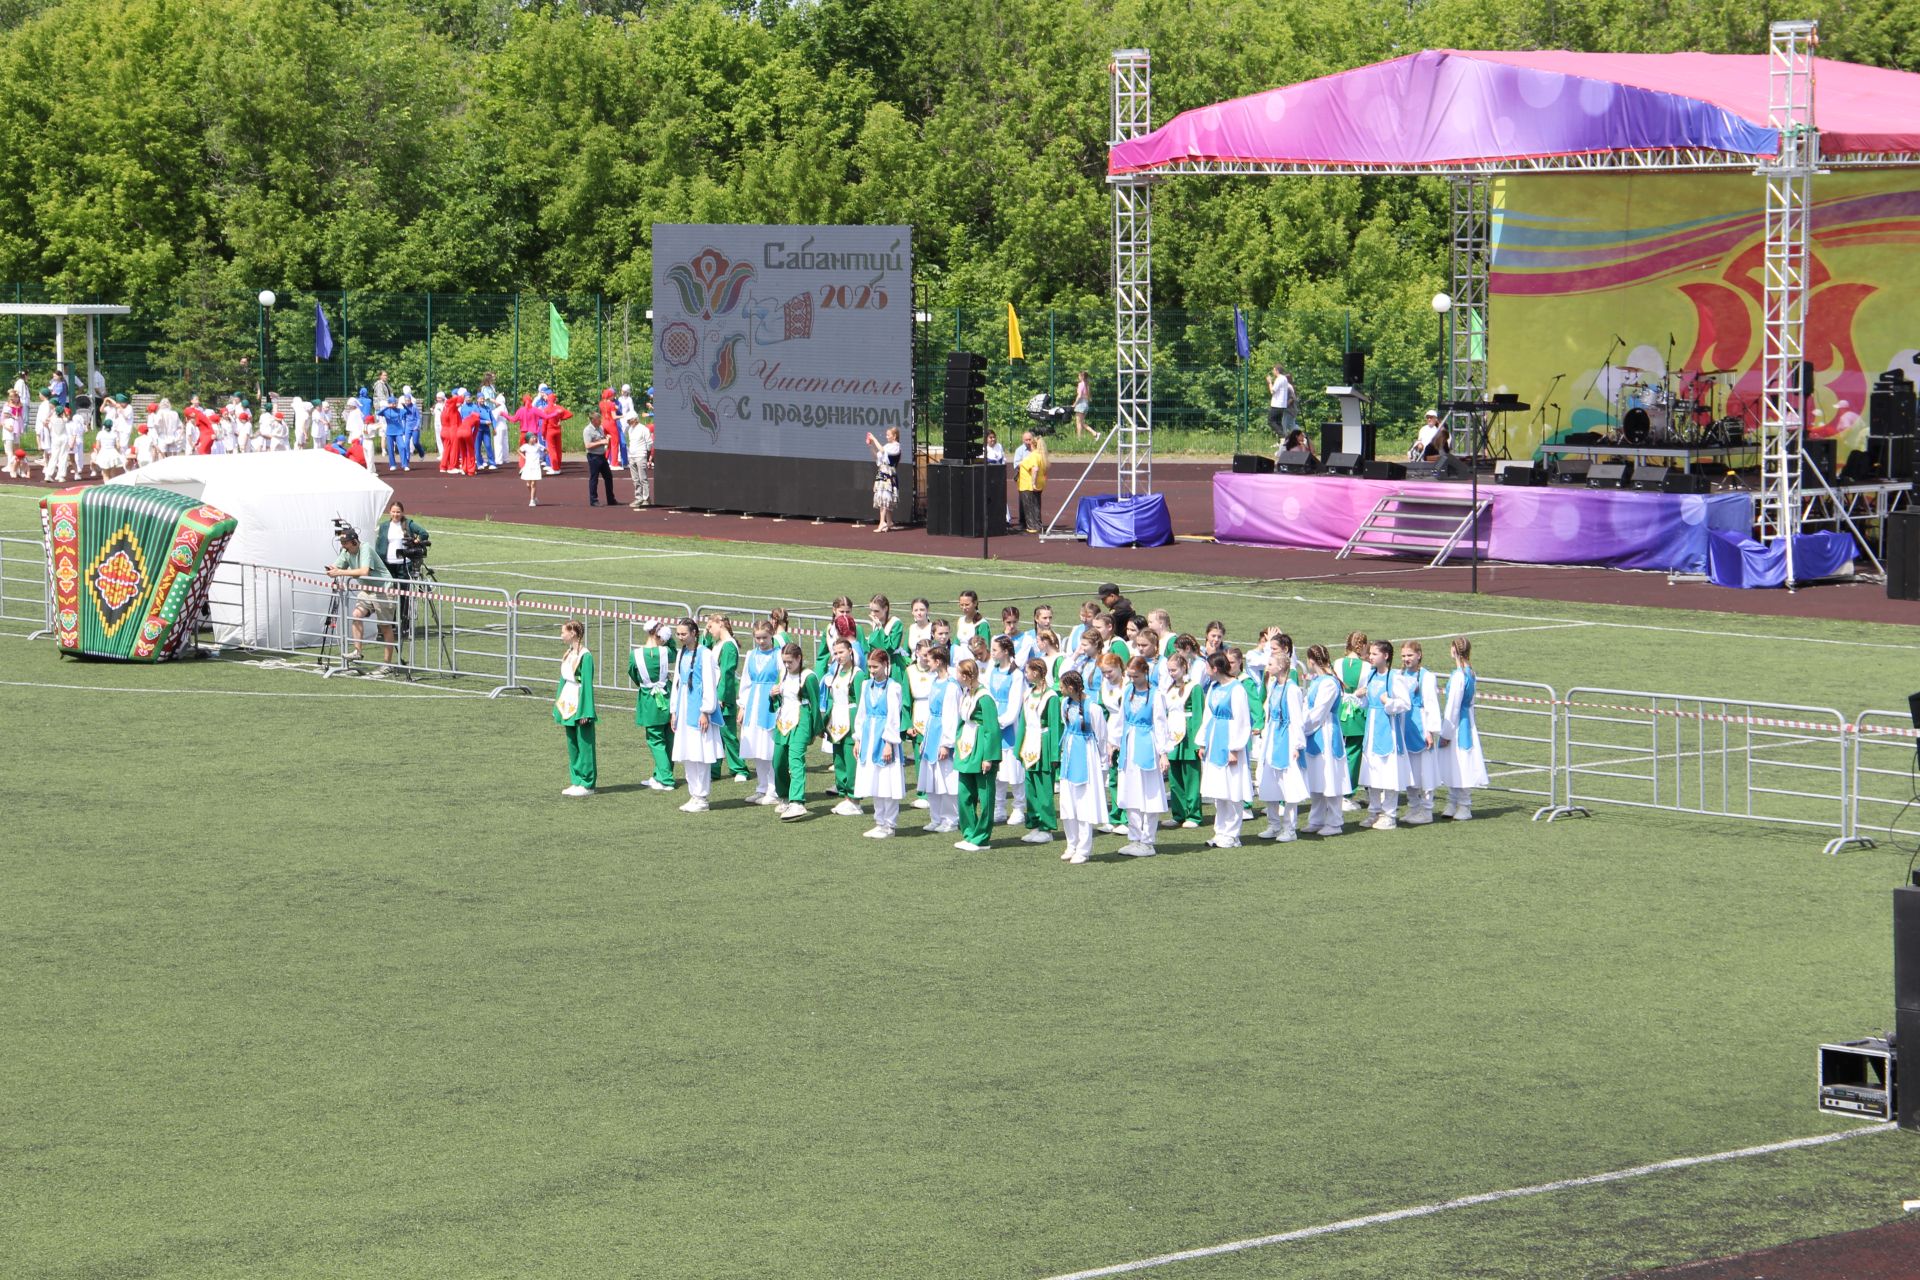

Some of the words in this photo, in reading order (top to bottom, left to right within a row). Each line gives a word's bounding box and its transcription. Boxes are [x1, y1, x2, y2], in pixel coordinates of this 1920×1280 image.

[764, 236, 903, 287] Сабантуй
[819, 284, 889, 310] 2025
[751, 359, 904, 395] Чистополь
[762, 400, 911, 429] праздником!
